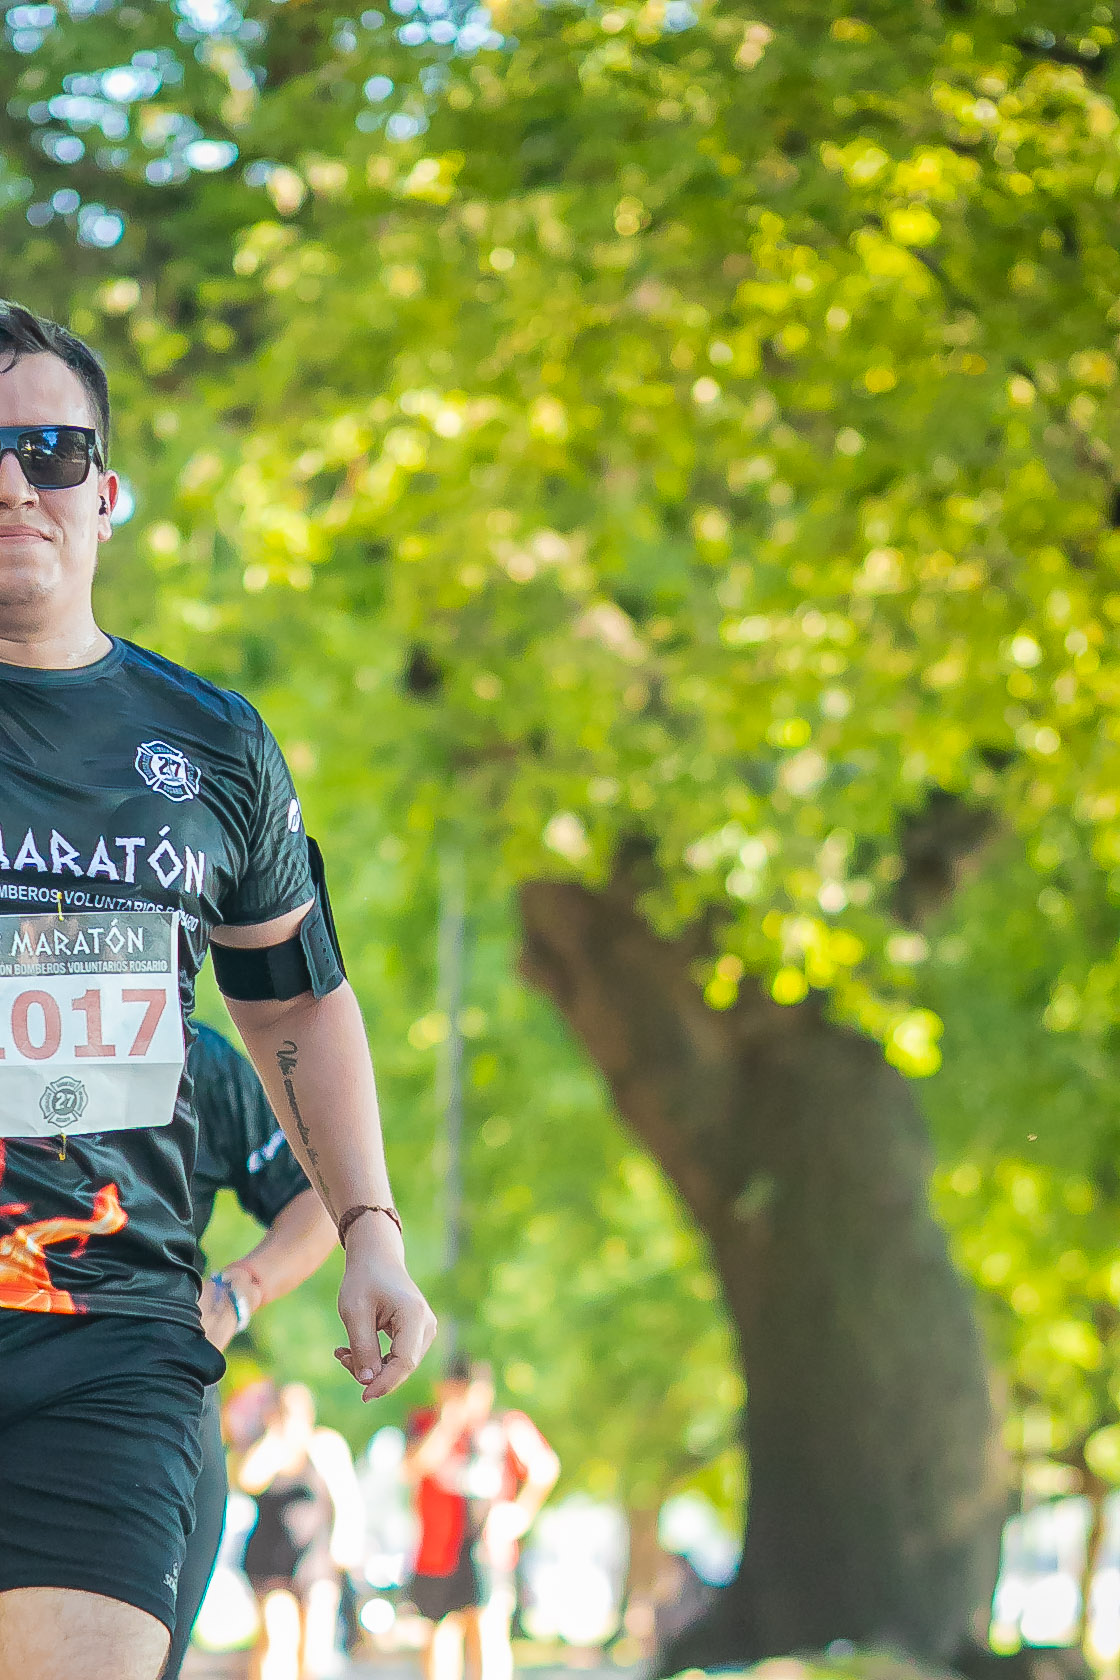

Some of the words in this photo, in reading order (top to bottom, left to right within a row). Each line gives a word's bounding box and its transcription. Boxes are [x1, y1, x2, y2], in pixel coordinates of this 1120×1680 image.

[158, 756, 181, 778] 27
[10, 917, 144, 957] MARATÓN
[14, 961, 67, 976] BOMBEROS
[67, 960, 129, 974] VOLUNTARIOS
[129, 959, 169, 973] ROSARIO
[54, 1091, 77, 1111] 27
